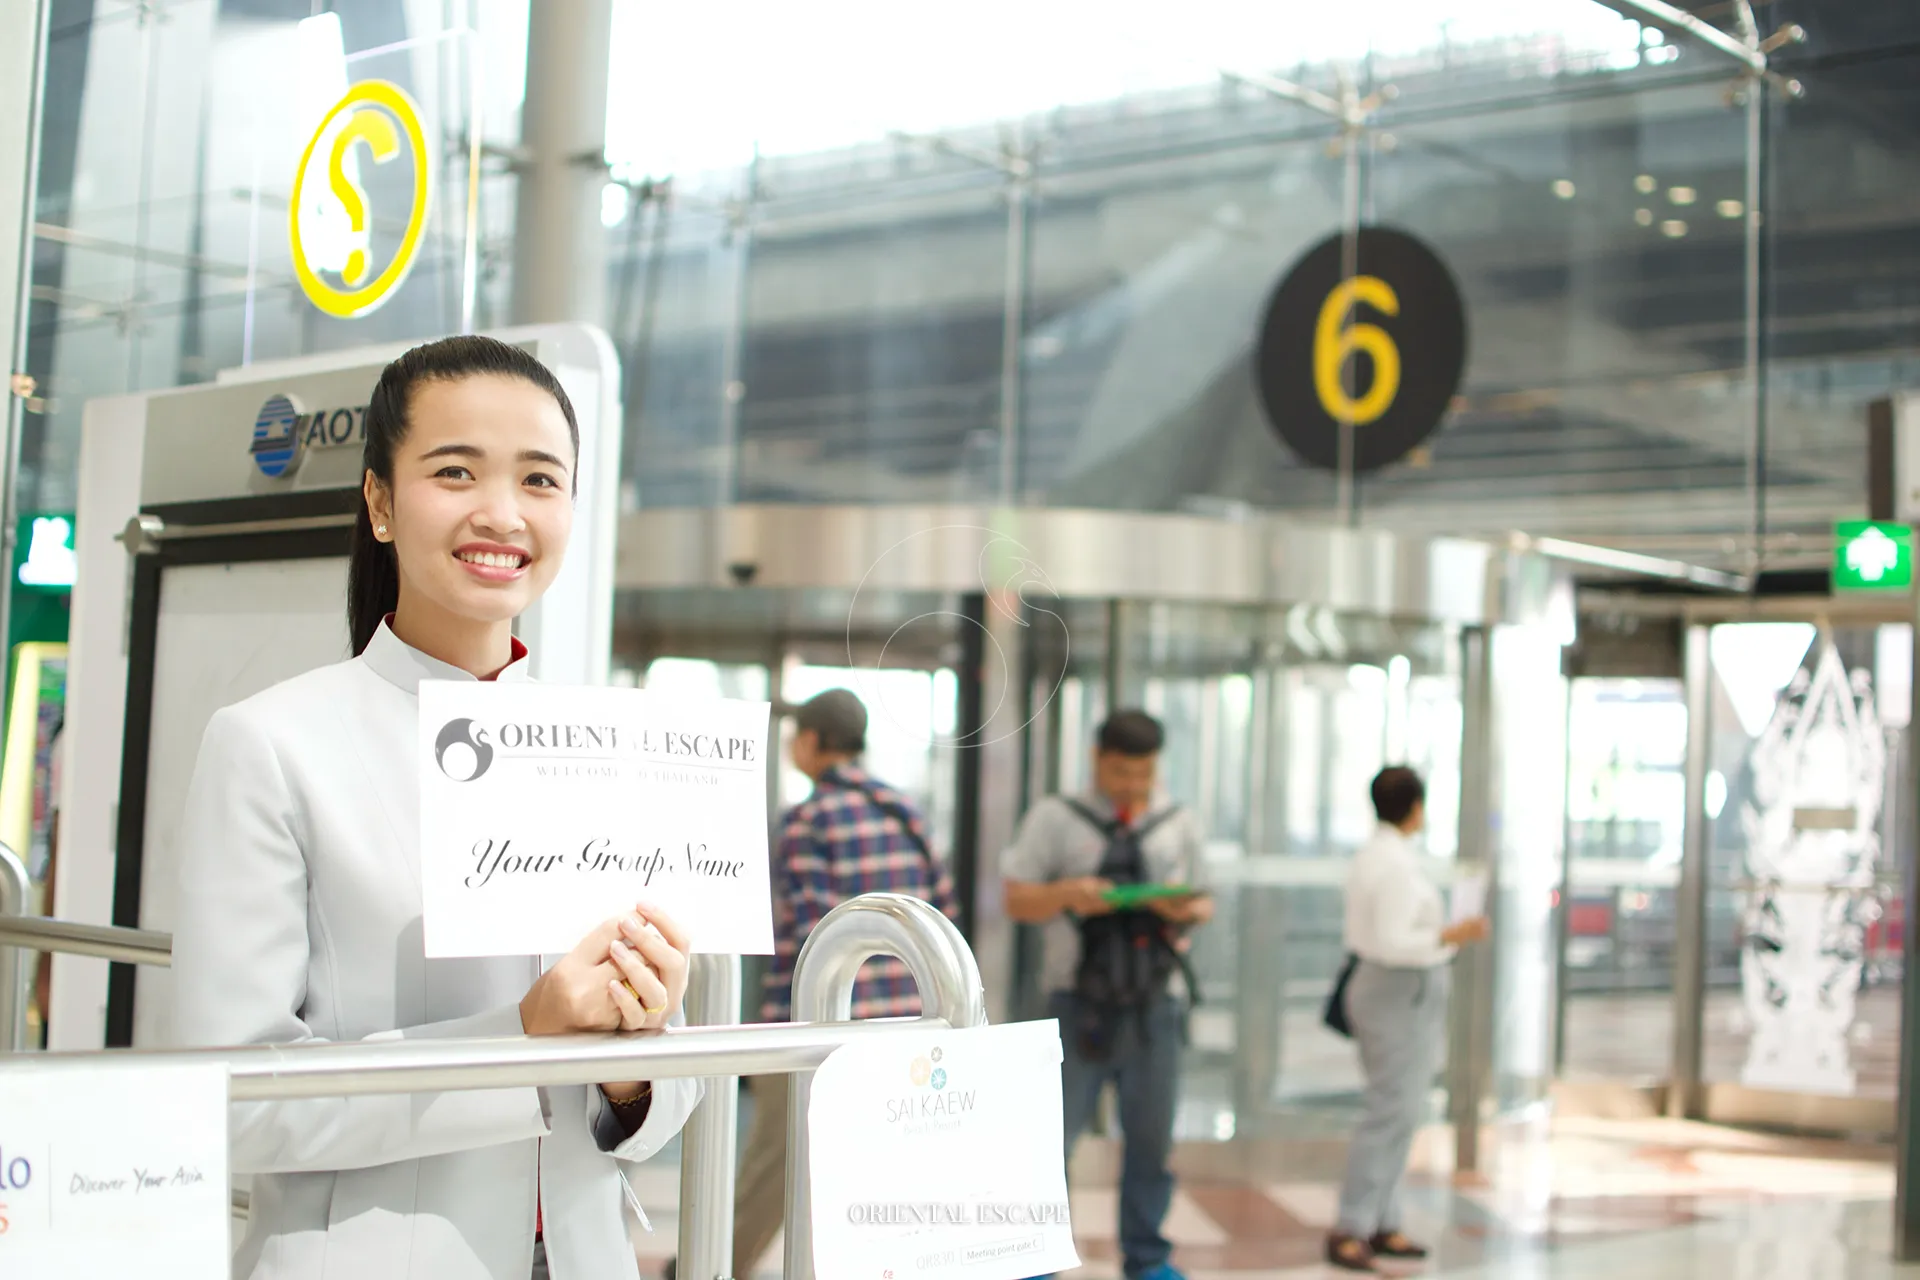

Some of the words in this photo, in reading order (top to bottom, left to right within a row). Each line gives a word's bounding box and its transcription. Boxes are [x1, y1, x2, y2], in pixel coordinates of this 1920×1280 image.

[1312, 274, 1401, 426] 6
[305, 406, 368, 446] AOT
[664, 731, 756, 762] ESCAPE
[464, 838, 564, 889] Your
[576, 837, 665, 887] Group
[668, 842, 745, 880] Name
[886, 1096, 915, 1123] SAI
[921, 1089, 976, 1118] KAEW
[69, 1171, 127, 1195] Discover
[132, 1166, 167, 1195] Your
[170, 1165, 205, 1187] Asia
[966, 1247, 996, 1261] Meeting
[997, 1243, 1015, 1257] point
[1016, 1241, 1032, 1253] gate
